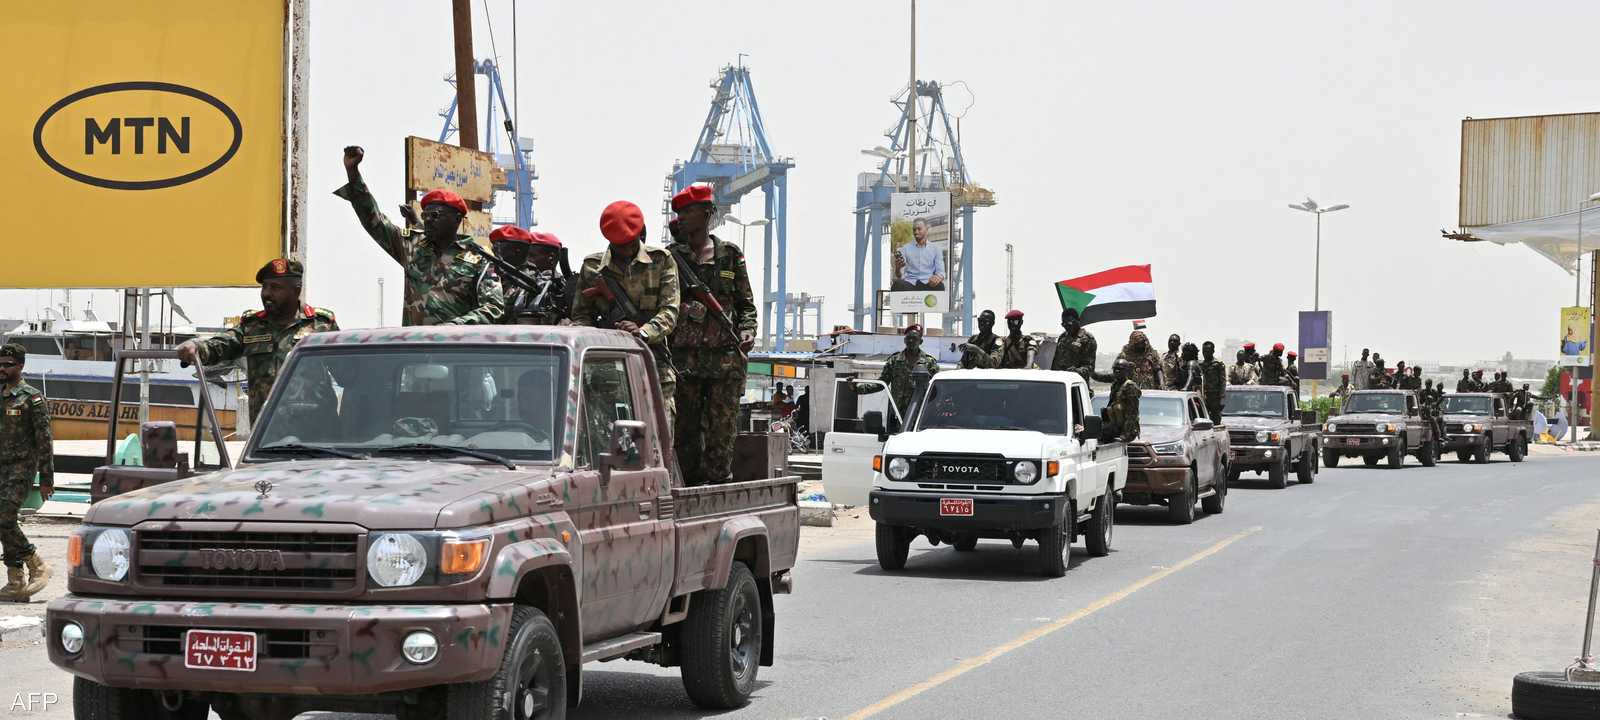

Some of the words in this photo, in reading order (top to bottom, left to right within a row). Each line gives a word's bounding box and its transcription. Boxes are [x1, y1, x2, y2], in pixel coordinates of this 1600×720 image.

[85, 117, 190, 155] MTN
[927, 199, 936, 209] في
[942, 465, 980, 473] TOYOTA
[200, 548, 286, 571] TOYOTA
